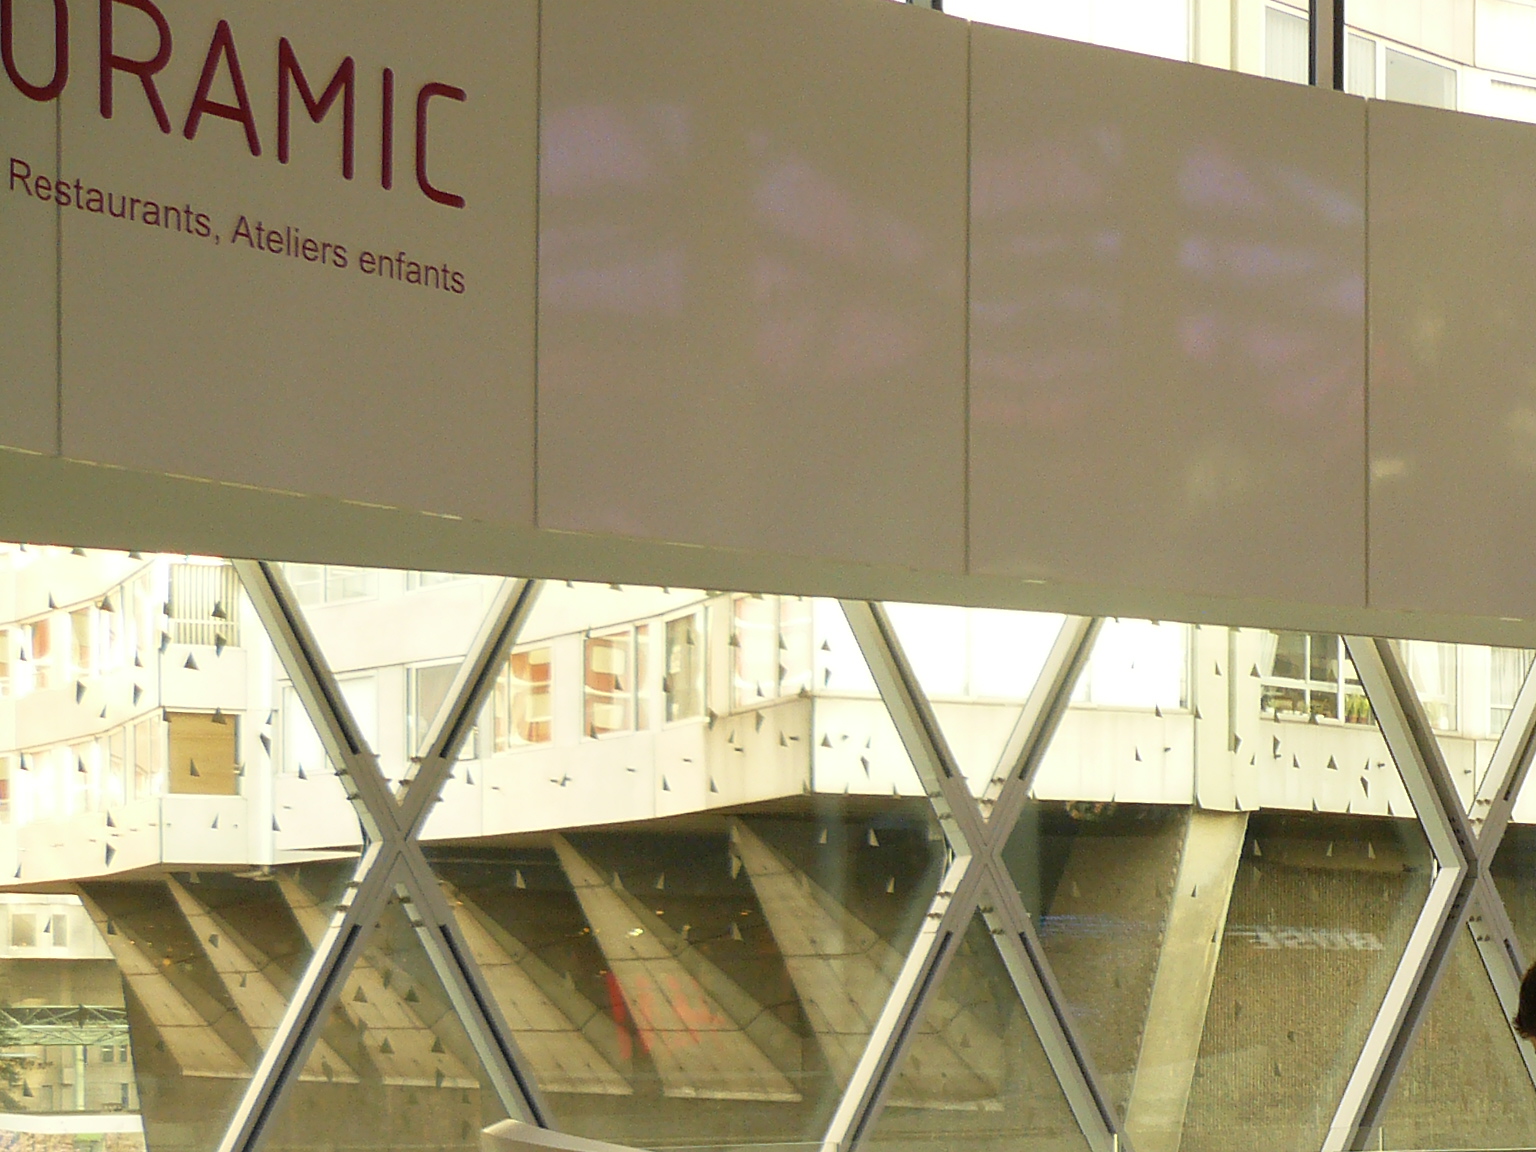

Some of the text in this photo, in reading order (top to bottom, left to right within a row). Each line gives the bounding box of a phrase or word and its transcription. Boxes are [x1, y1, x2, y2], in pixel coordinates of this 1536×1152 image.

[9, 157, 466, 295] Restaurants, Ateliers enfants
